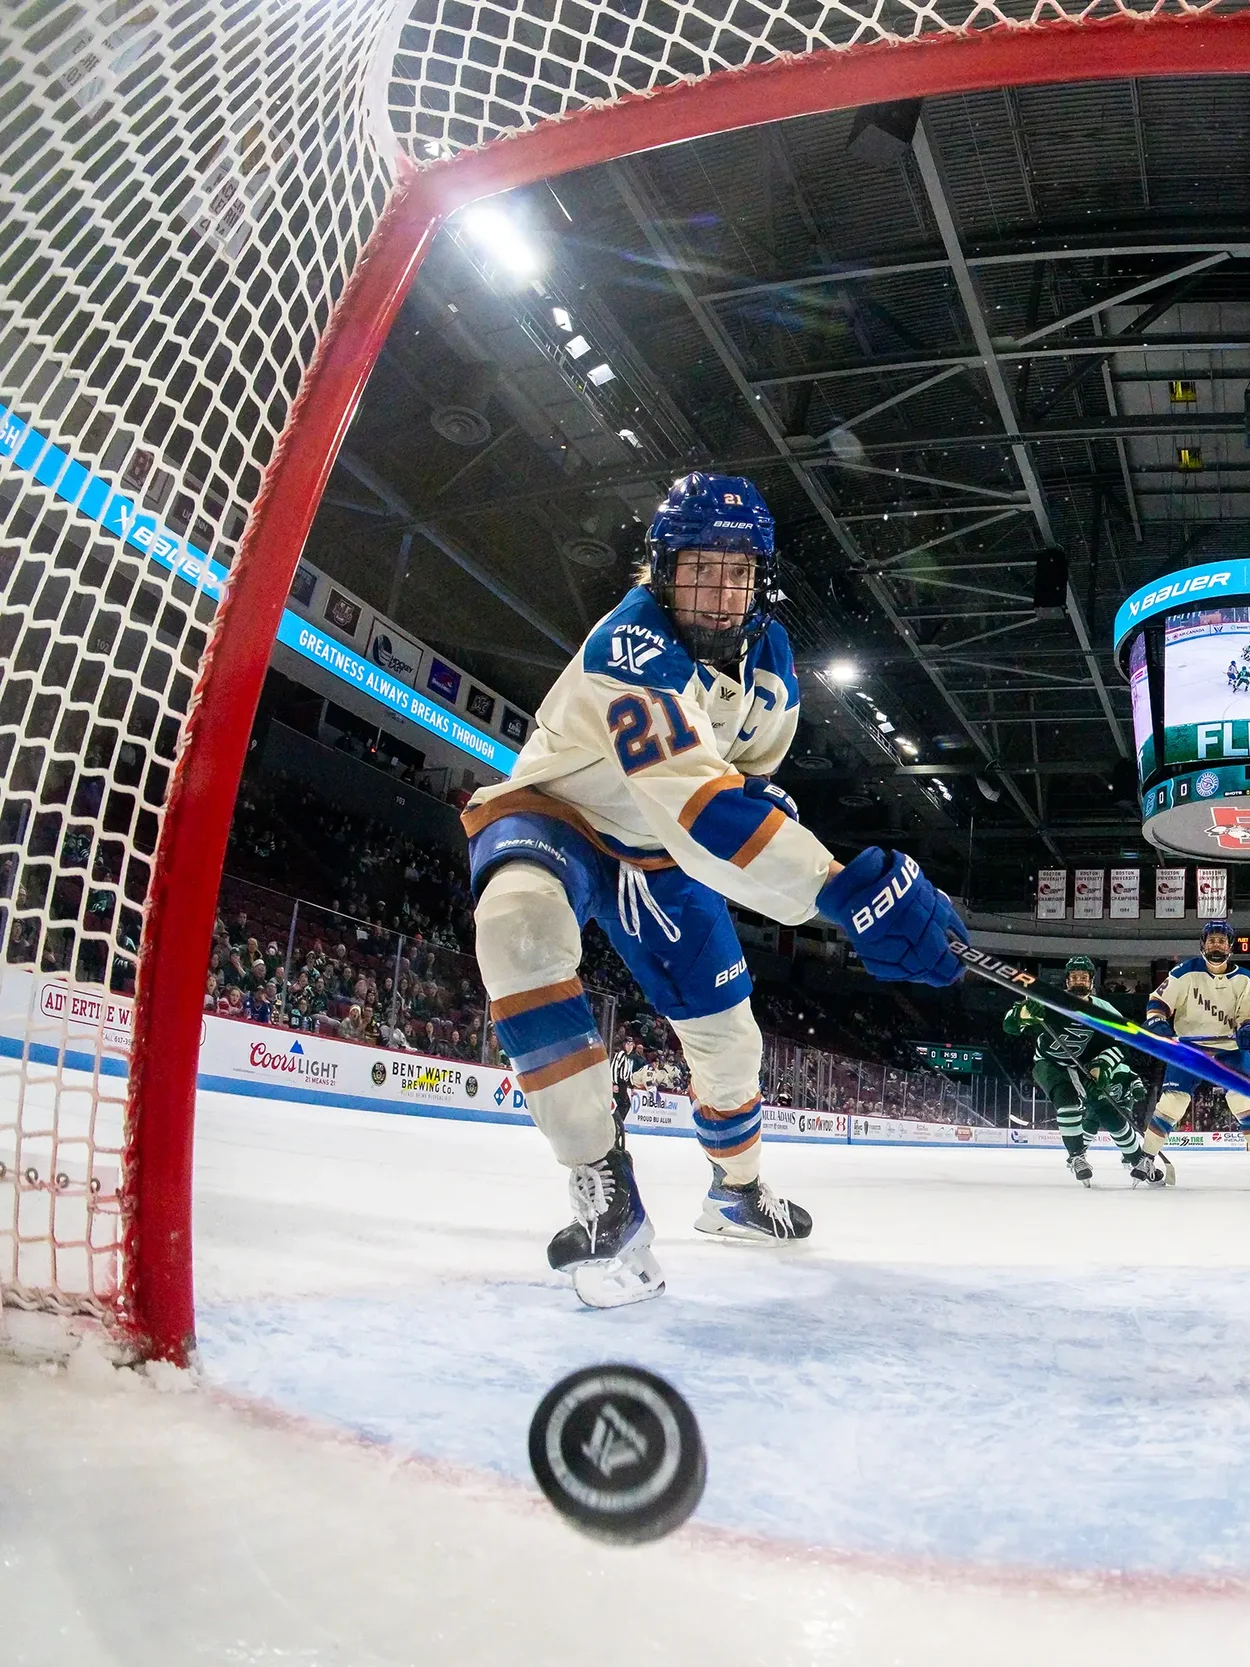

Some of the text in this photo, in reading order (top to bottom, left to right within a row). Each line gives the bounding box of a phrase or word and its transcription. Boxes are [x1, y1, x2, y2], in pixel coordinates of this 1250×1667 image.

[723, 493, 743, 506] 21
[613, 624, 667, 650] PWHL
[298, 629, 364, 681] GREATNESS
[365, 672, 409, 708] ALWAYS
[411, 695, 449, 732] BREAKS
[452, 722, 495, 760] THROUGH
[606, 687, 702, 777] 21
[852, 854, 920, 935] BAUE
[949, 940, 1037, 988] BAUER
[45, 992, 115, 1023] ADERTIE
[249, 1041, 296, 1073] Coors
[297, 1061, 339, 1080] LIGHT
[392, 1061, 462, 1085] BENT WATER
[401, 1078, 440, 1093] BREWING
[777, 1111, 796, 1125] ADAMS
